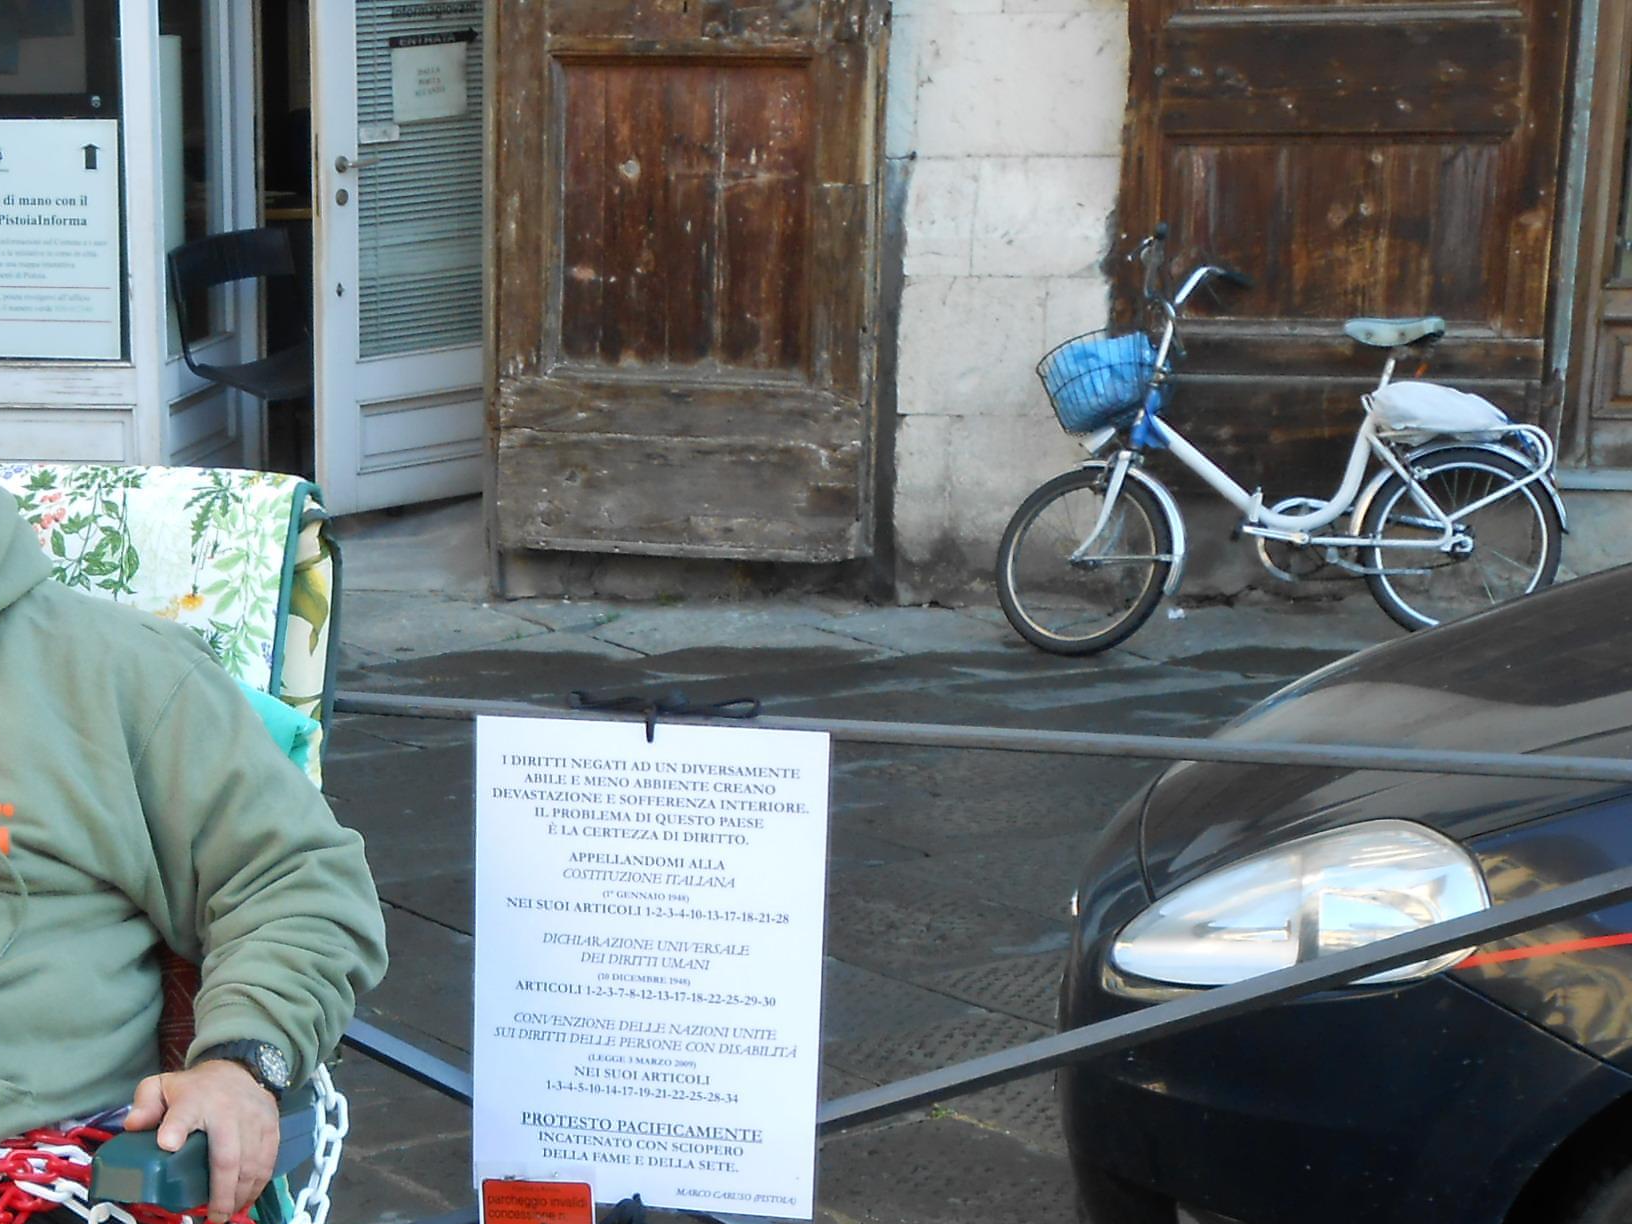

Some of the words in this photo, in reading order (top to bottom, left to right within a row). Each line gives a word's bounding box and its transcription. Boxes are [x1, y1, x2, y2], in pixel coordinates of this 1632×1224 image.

[2, 193, 14, 206] di
[18, 197, 52, 206] mano
[55, 197, 76, 207] con
[79, 194, 87, 206] il
[511, 754, 566, 768] DIRITTI
[570, 757, 626, 771] NEGATI
[630, 761, 651, 772] AD
[655, 761, 677, 773] UN
[681, 763, 800, 779] DIVERSAMENTE
[524, 772, 567, 785] ABILE
[571, 775, 580, 786] E
[583, 775, 629, 788] MENO
[633, 778, 709, 792] ABBIENTE
[712, 782, 776, 795] CREANO
[492, 787, 602, 804] DEVASTAZIONE
[606, 793, 615, 804] E
[619, 794, 716, 809] SOFFERENZA
[720, 799, 808, 814] INTERIORE.
[534, 806, 549, 818] IL
[552, 807, 631, 822] PROBLEMA
[635, 811, 651, 823] DI
[655, 812, 715, 826] QUESTO
[719, 816, 763, 829] PAESE
[548, 821, 557, 835] È
[561, 824, 578, 836] LA
[582, 825, 658, 840] CERTEZZA
[663, 830, 678, 841] DI
[683, 831, 748, 845] DIRITTO.
[569, 851, 684, 868] APPELLANDOMI
[688, 858, 724, 870] ALLA
[562, 867, 662, 884] COSTITUZIONE
[665, 873, 735, 888] ITALIANA
[506, 896, 532, 909] NEI
[535, 898, 569, 911] SUOI
[573, 901, 641, 916] ARTICOLI
[542, 932, 653, 950] DICHIARAZIONE
[657, 939, 749, 956] UNIVERSALE
[580, 951, 605, 964] DEI
[607, 952, 658, 968] DIRITTI
[661, 956, 710, 971] UMANI
[515, 979, 581, 995] ARTICOLI
[611, 972, 666, 984] DICEMBRE
[513, 1011, 615, 1031] CONVENZIONE
[618, 1019, 666, 1034] DELLE
[668, 1023, 729, 1038] NAZIONI
[732, 1027, 776, 1041] UNITE
[493, 1026, 516, 1039] SUI
[518, 1027, 568, 1043] DIRITTI
[569, 1032, 616, 1047] DELLE
[618, 1036, 682, 1051] PERSONE
[684, 1041, 715, 1053] CON
[635, 1056, 672, 1066] MARZO
[574, 1065, 599, 1078] NEI
[603, 1068, 637, 1080] SUOI
[641, 1071, 709, 1086] ARTICOLI
[521, 1111, 612, 1133] PROTESTO
[617, 1119, 763, 1144] PACIFICAMENTE
[538, 1130, 632, 1148] INCATENATO
[635, 1139, 667, 1151] CON
[671, 1142, 743, 1156] SCIOPERO
[542, 1147, 588, 1161] DELLA
[592, 1151, 630, 1164] FAME
[634, 1155, 644, 1166] E
[648, 1156, 695, 1169] DELLA
[698, 1159, 738, 1173] SETE.
[675, 1187, 712, 1198] MARCO
